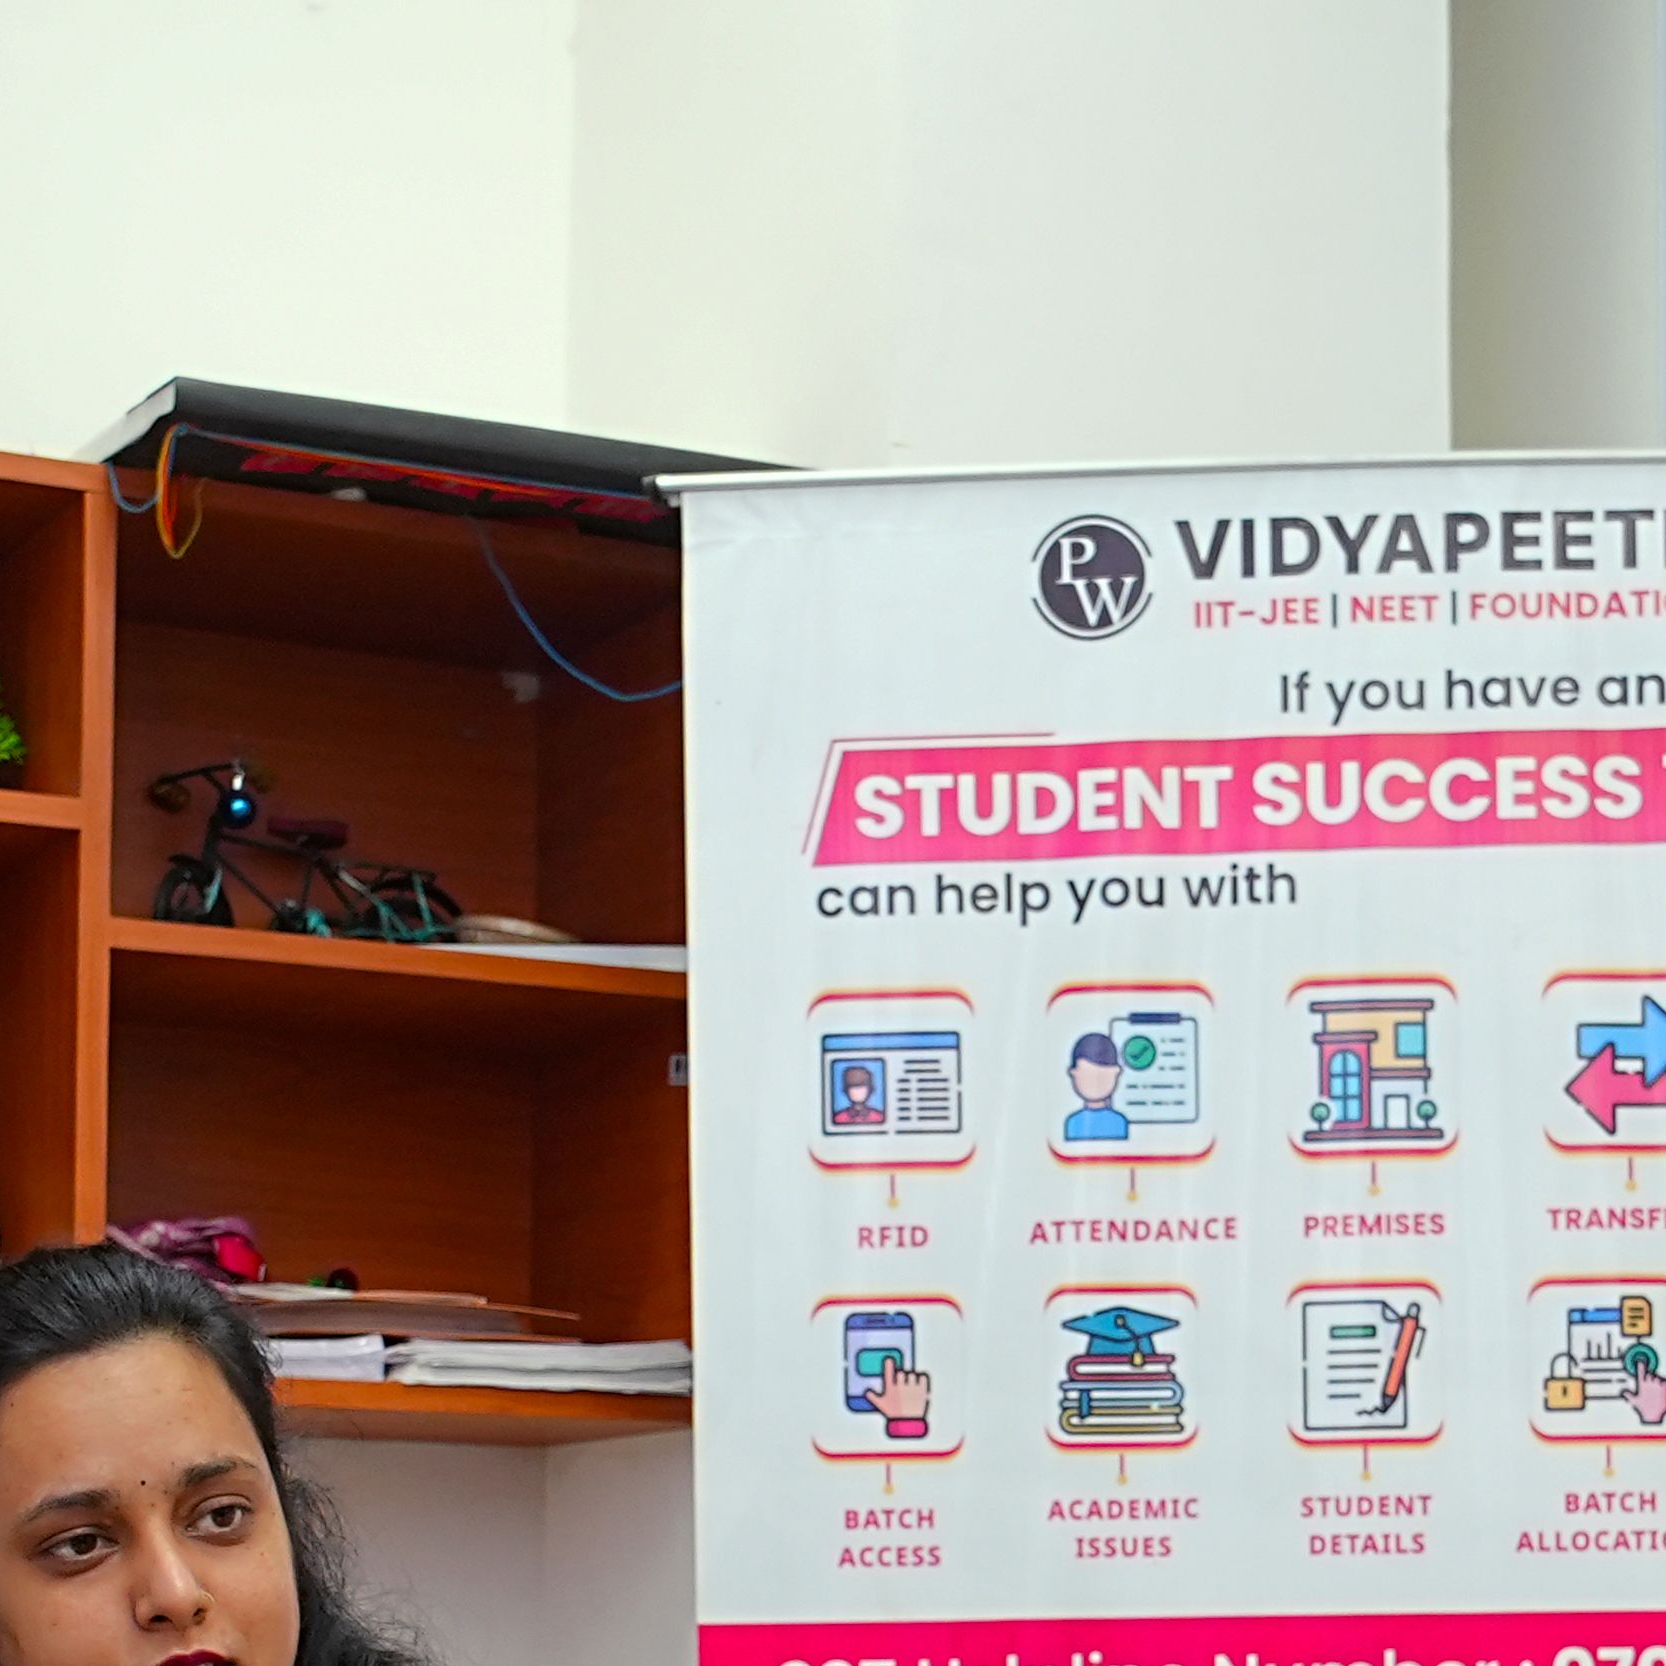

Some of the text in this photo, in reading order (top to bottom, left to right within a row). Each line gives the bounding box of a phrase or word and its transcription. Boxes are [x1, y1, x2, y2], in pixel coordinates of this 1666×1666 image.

[1195, 598, 1319, 628] IIT-JEE
[1351, 595, 1439, 622] NEET
[1282, 671, 1309, 712] If
[1326, 680, 1424, 726] you
[1446, 670, 1579, 709] have
[855, 766, 1233, 838] STUDENT
[1253, 755, 1643, 825] SUCCESS
[817, 863, 1296, 926] can help you with
[1030, 1217, 1236, 1244] ATTENDANCE
[1304, 1213, 1444, 1237] PREMISES
[859, 1226, 928, 1248] RFID
[1048, 1498, 1197, 1520] ACADEMIC
[1301, 1495, 1431, 1517] STUDENT
[1565, 1492, 1656, 1513] BATCH
[845, 1509, 933, 1529] BATCH
[1076, 1536, 1171, 1558] ISSUES
[1310, 1533, 1424, 1555] DETAILS
[839, 1546, 940, 1567] ACCESS
